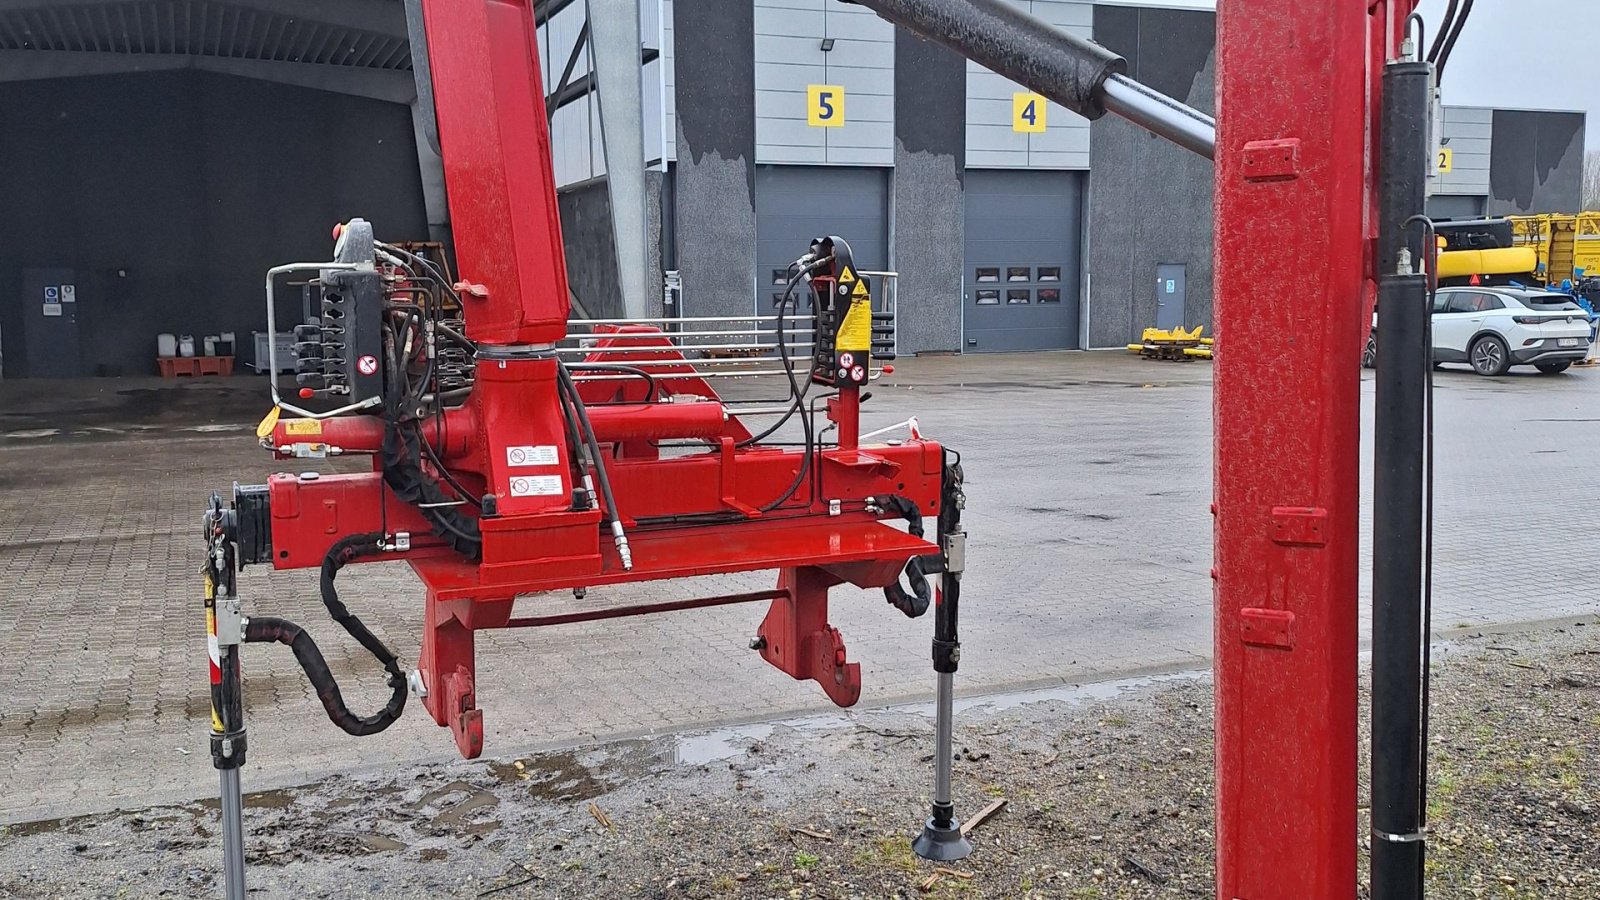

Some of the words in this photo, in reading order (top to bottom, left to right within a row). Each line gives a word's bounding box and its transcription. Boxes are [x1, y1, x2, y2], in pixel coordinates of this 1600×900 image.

[819, 92, 833, 120] 5
[1021, 99, 1036, 126] 4
[1438, 152, 1447, 169] 2
